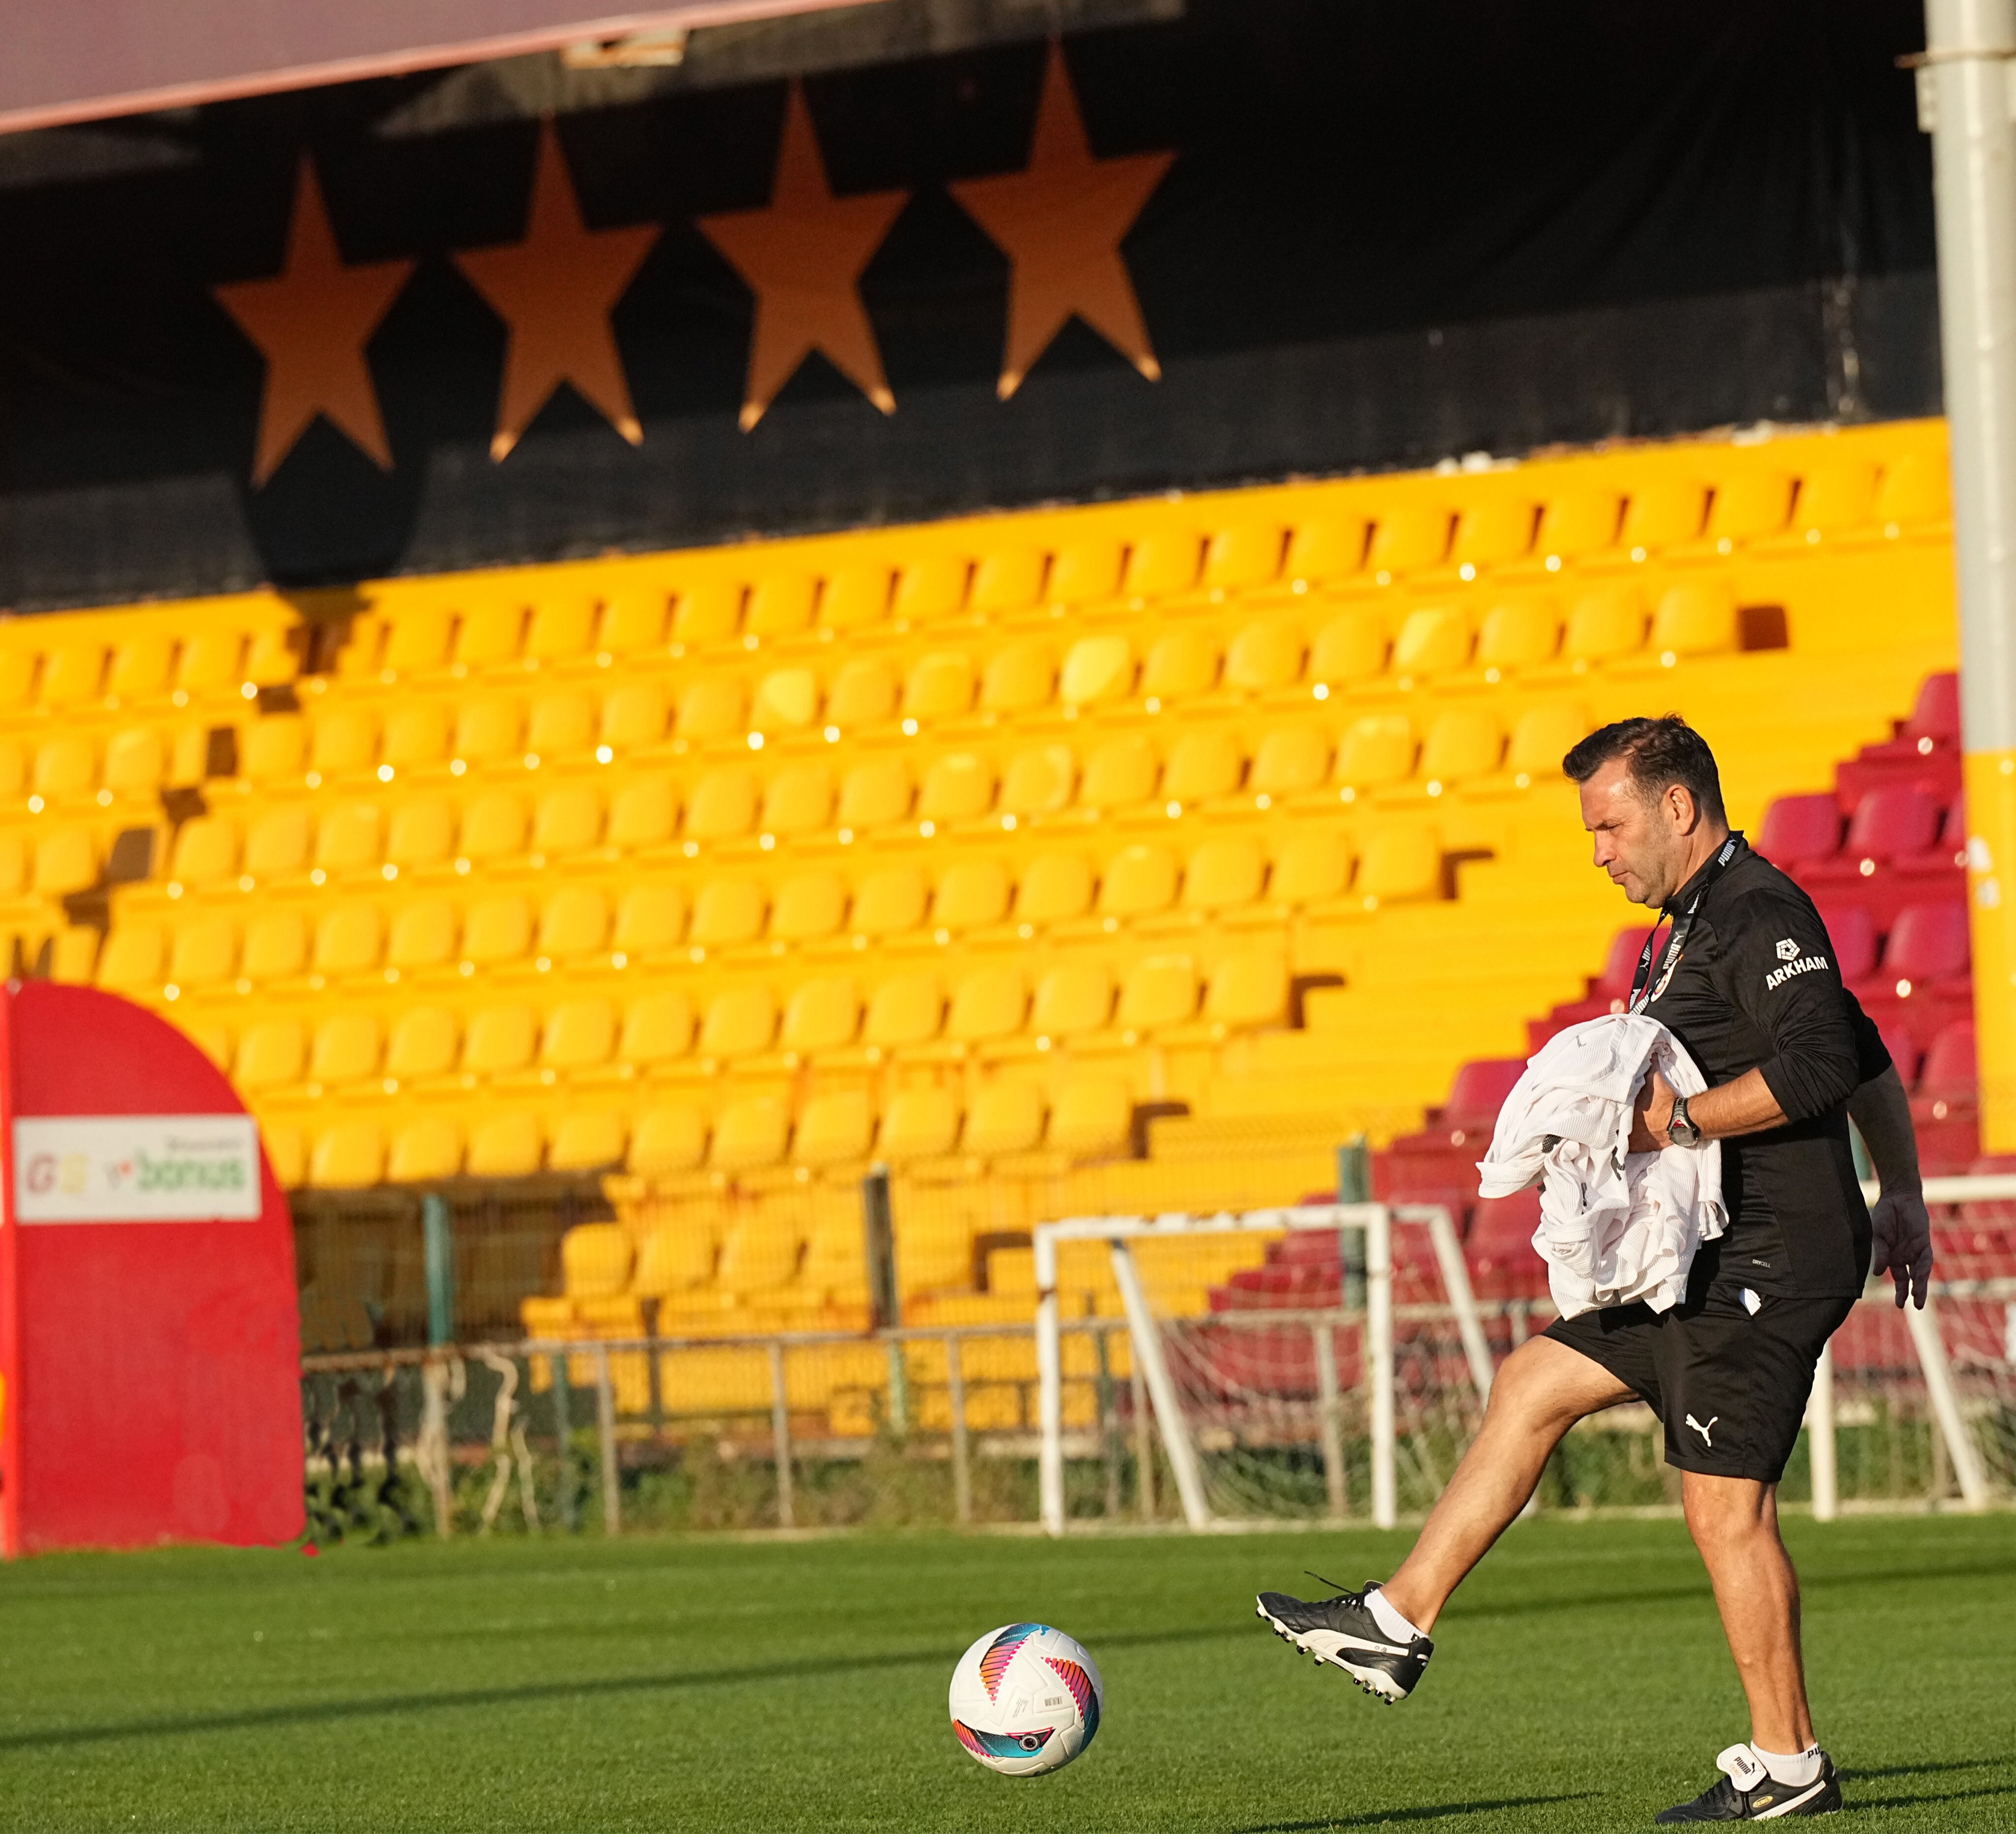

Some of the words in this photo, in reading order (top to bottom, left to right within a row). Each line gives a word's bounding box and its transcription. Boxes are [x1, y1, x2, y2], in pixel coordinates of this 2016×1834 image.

[1718, 842, 1735, 867] PUMA
[1663, 942, 1681, 970] PUMA
[1765, 956, 1829, 991] ARKHAM
[1752, 1259, 1771, 1268] DRYCELL
[1733, 1756, 1751, 1775] PUMA
